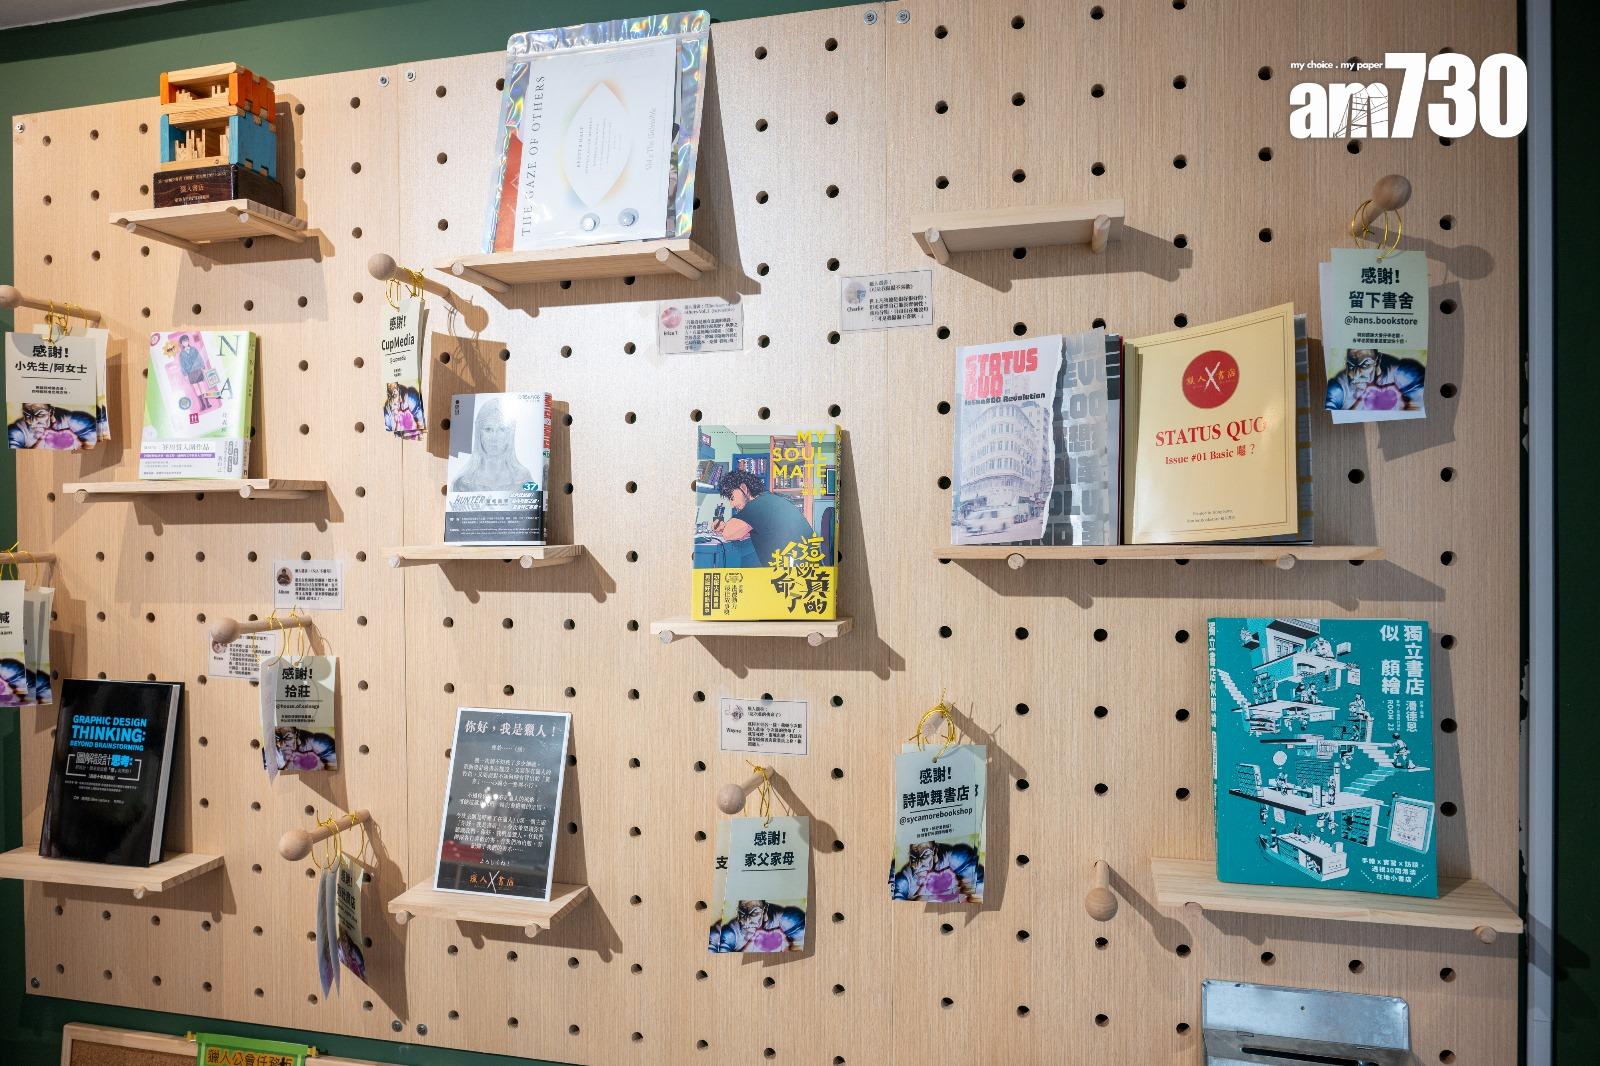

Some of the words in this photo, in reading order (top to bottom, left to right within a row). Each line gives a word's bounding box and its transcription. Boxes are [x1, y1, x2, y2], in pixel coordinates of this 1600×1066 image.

[531, 75, 546, 133] OTHERS
[528, 138, 539, 156] OF
[526, 160, 538, 202] GAZE
[522, 205, 534, 237] THE
[1349, 291, 1414, 310] 留下書舍
[1344, 315, 1418, 326] @hans.bookstore
[381, 333, 415, 352] CupMedia
[15, 361, 88, 374] 小先生/阿女士
[965, 347, 1038, 375] STATUS
[1003, 392, 1045, 403] Revolution
[797, 431, 826, 444] MY
[1155, 424, 1221, 447] STATUS
[772, 447, 827, 463] SOUL
[1165, 454, 1189, 465] Issue
[1191, 452, 1207, 462] #01
[1209, 448, 1234, 460] Basic
[772, 465, 827, 479] MATE
[1404, 625, 1424, 696] 獨立書店
[285, 684, 311, 698] 拾莊
[72, 715, 111, 726] GRAPHIC
[112, 717, 147, 727] DESIGN
[71, 725, 146, 743] THINKING:
[70, 741, 94, 749] BEYOND
[94, 742, 144, 752] BRAINSTORMING
[902, 784, 970, 810] 詩歌舞書店
[899, 806, 973, 826] @sycamorebookshop
[744, 851, 795, 868] 家父家母
